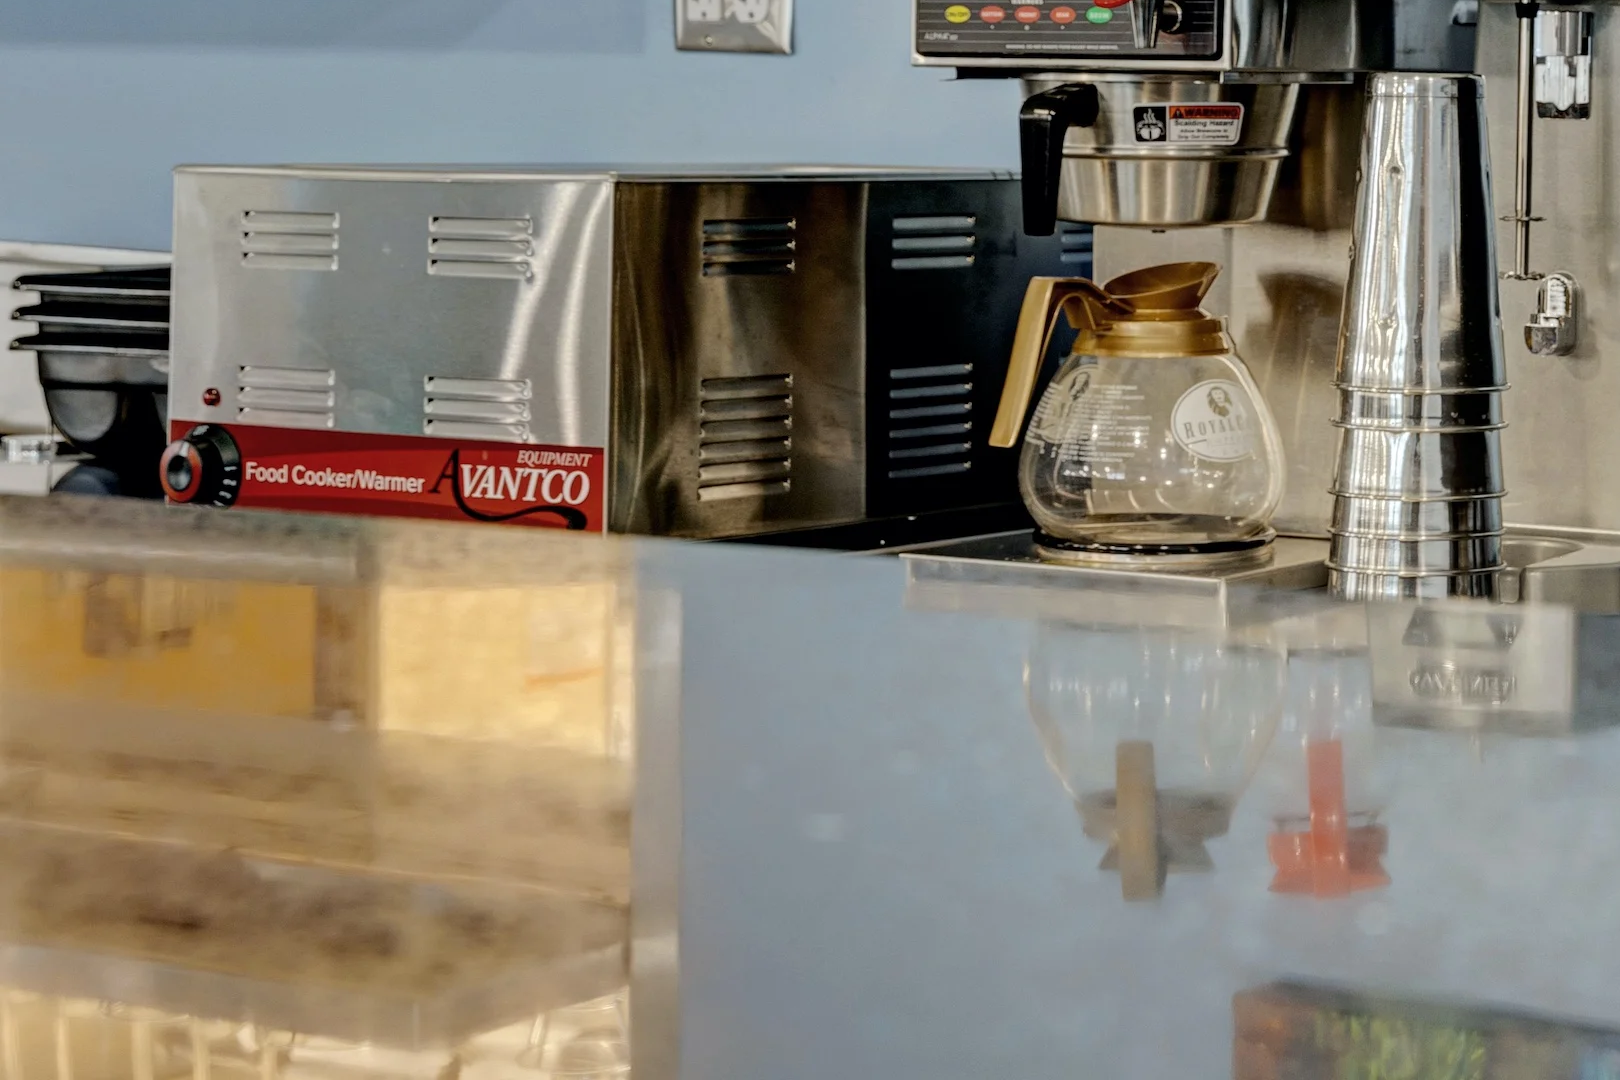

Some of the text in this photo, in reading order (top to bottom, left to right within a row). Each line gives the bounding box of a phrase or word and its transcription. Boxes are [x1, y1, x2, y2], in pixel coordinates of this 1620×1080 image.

[1184, 108, 1238, 117] WARNING
[517, 449, 593, 467] EQUIPMENT
[245, 461, 426, 494] Food Cooker/Warmer
[428, 448, 591, 518] AVANTCO
